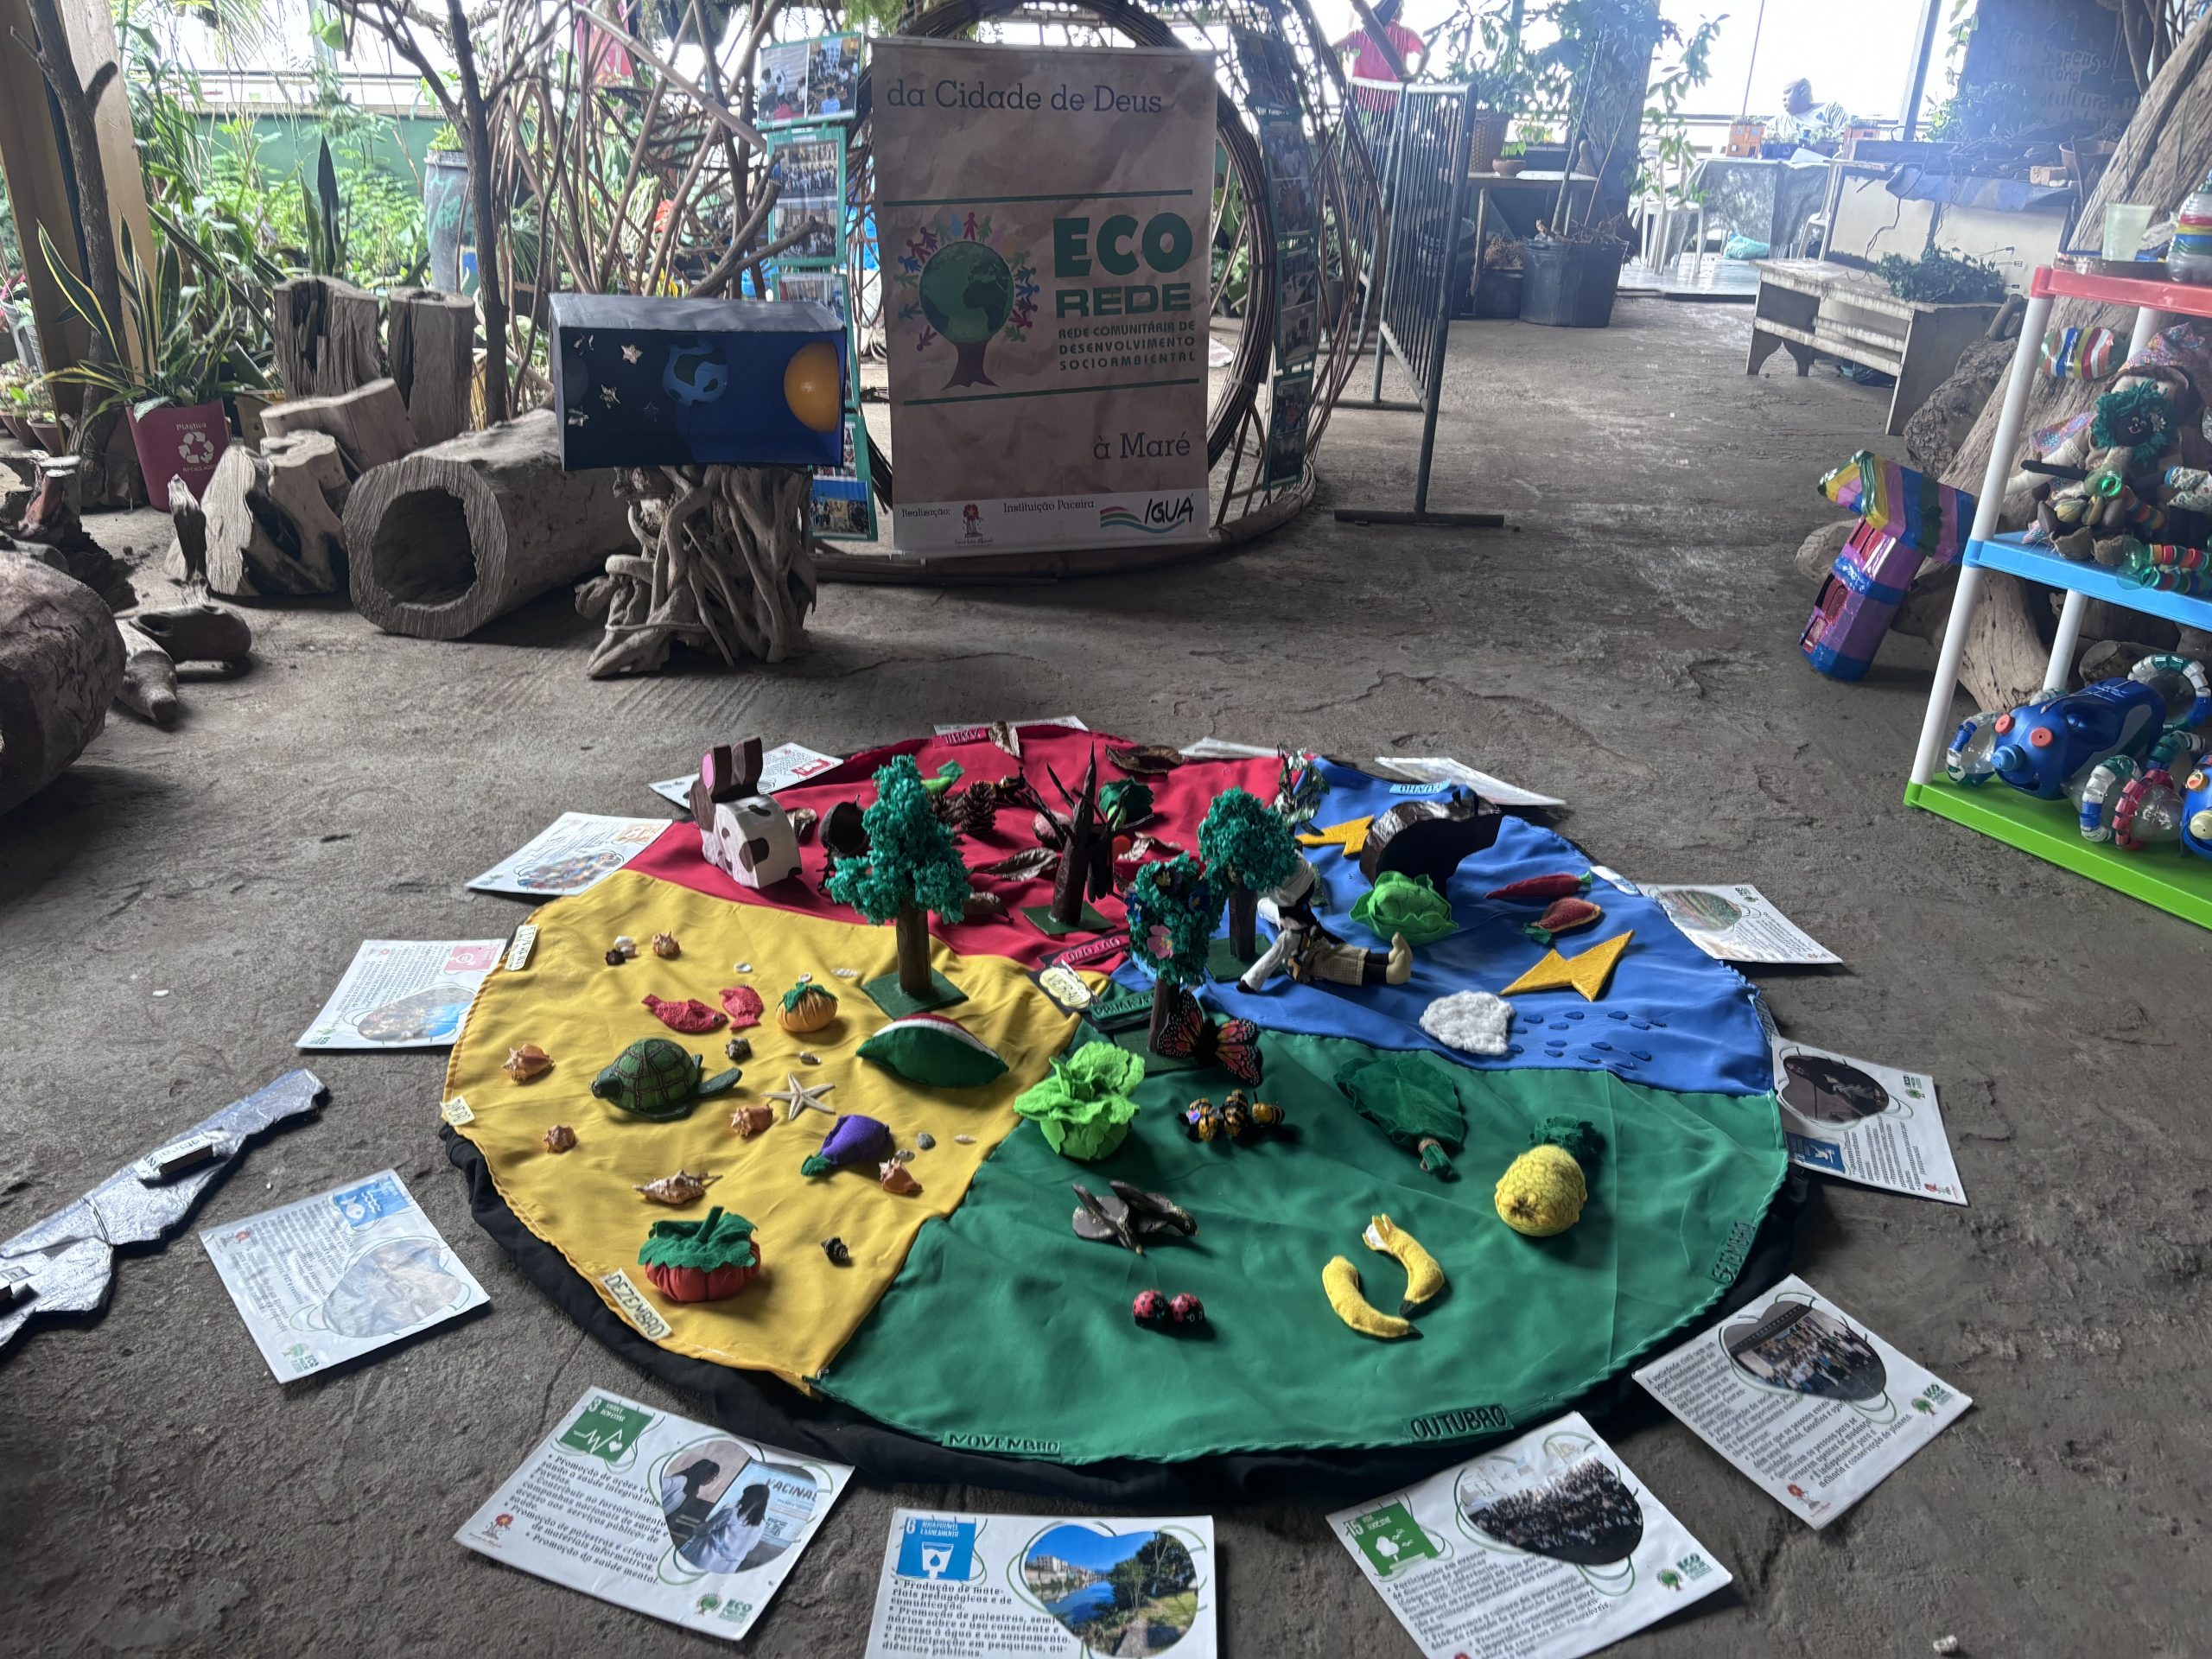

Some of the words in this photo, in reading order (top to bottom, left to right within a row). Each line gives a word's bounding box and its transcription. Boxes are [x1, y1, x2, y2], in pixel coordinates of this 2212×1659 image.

[887, 79, 925, 107] da
[936, 79, 1042, 110] Cidade
[1051, 85, 1085, 111] de
[1094, 85, 1161, 113] Deus
[1053, 213, 1193, 277] ECO
[1056, 283, 1192, 318] REDE
[1058, 327, 1089, 339] REDE
[1093, 321, 1175, 336] COMUNITÁRIA
[1179, 321, 1195, 331] DE
[1059, 336, 1195, 355] DESENVOLVIMENTO
[1059, 352, 1195, 371] SOCIOAMBIENTAL
[1093, 435, 1110, 460] à
[1120, 433, 1191, 459] Maré
[1003, 500, 1054, 513] Instituição
[605, 1274, 664, 1337] DEZEMBRO
[1410, 1406, 1507, 1439] OUTUBRO
[950, 1434, 1059, 1452] NOVEMBRO
[541, 1461, 568, 1474] sando
[576, 1473, 603, 1487] saúde
[605, 1483, 642, 1500] integral
[555, 1456, 599, 1477] Promoção
[600, 1472, 611, 1481] de
[613, 1478, 638, 1490] ações
[523, 1482, 574, 1504] campanhas
[575, 1502, 620, 1521] nacionais
[620, 1516, 632, 1525] de
[633, 1522, 661, 1535] saúde
[537, 1477, 583, 1498] Contribuir
[599, 1499, 668, 1527] fortalecimento
[531, 1522, 543, 1531] de
[544, 1529, 588, 1548] materiais
[547, 1501, 563, 1510] aos
[567, 1508, 605, 1525] serviços
[646, 1534, 658, 1543] de
[557, 1522, 569, 1531] de
[569, 1528, 613, 1548] palestras
[532, 1534, 578, 1555] Promoção
[594, 1558, 621, 1572] saúde
[903, 1580, 954, 1592] Produção
[921, 1589, 988, 1604] pedagógicos
[887, 1615, 923, 1625] nários
[991, 1621, 1050, 1632] consciente
[898, 1605, 954, 1618] Promoção
[893, 1632, 964, 1647] Participação
[895, 1626, 931, 1635] acesso
